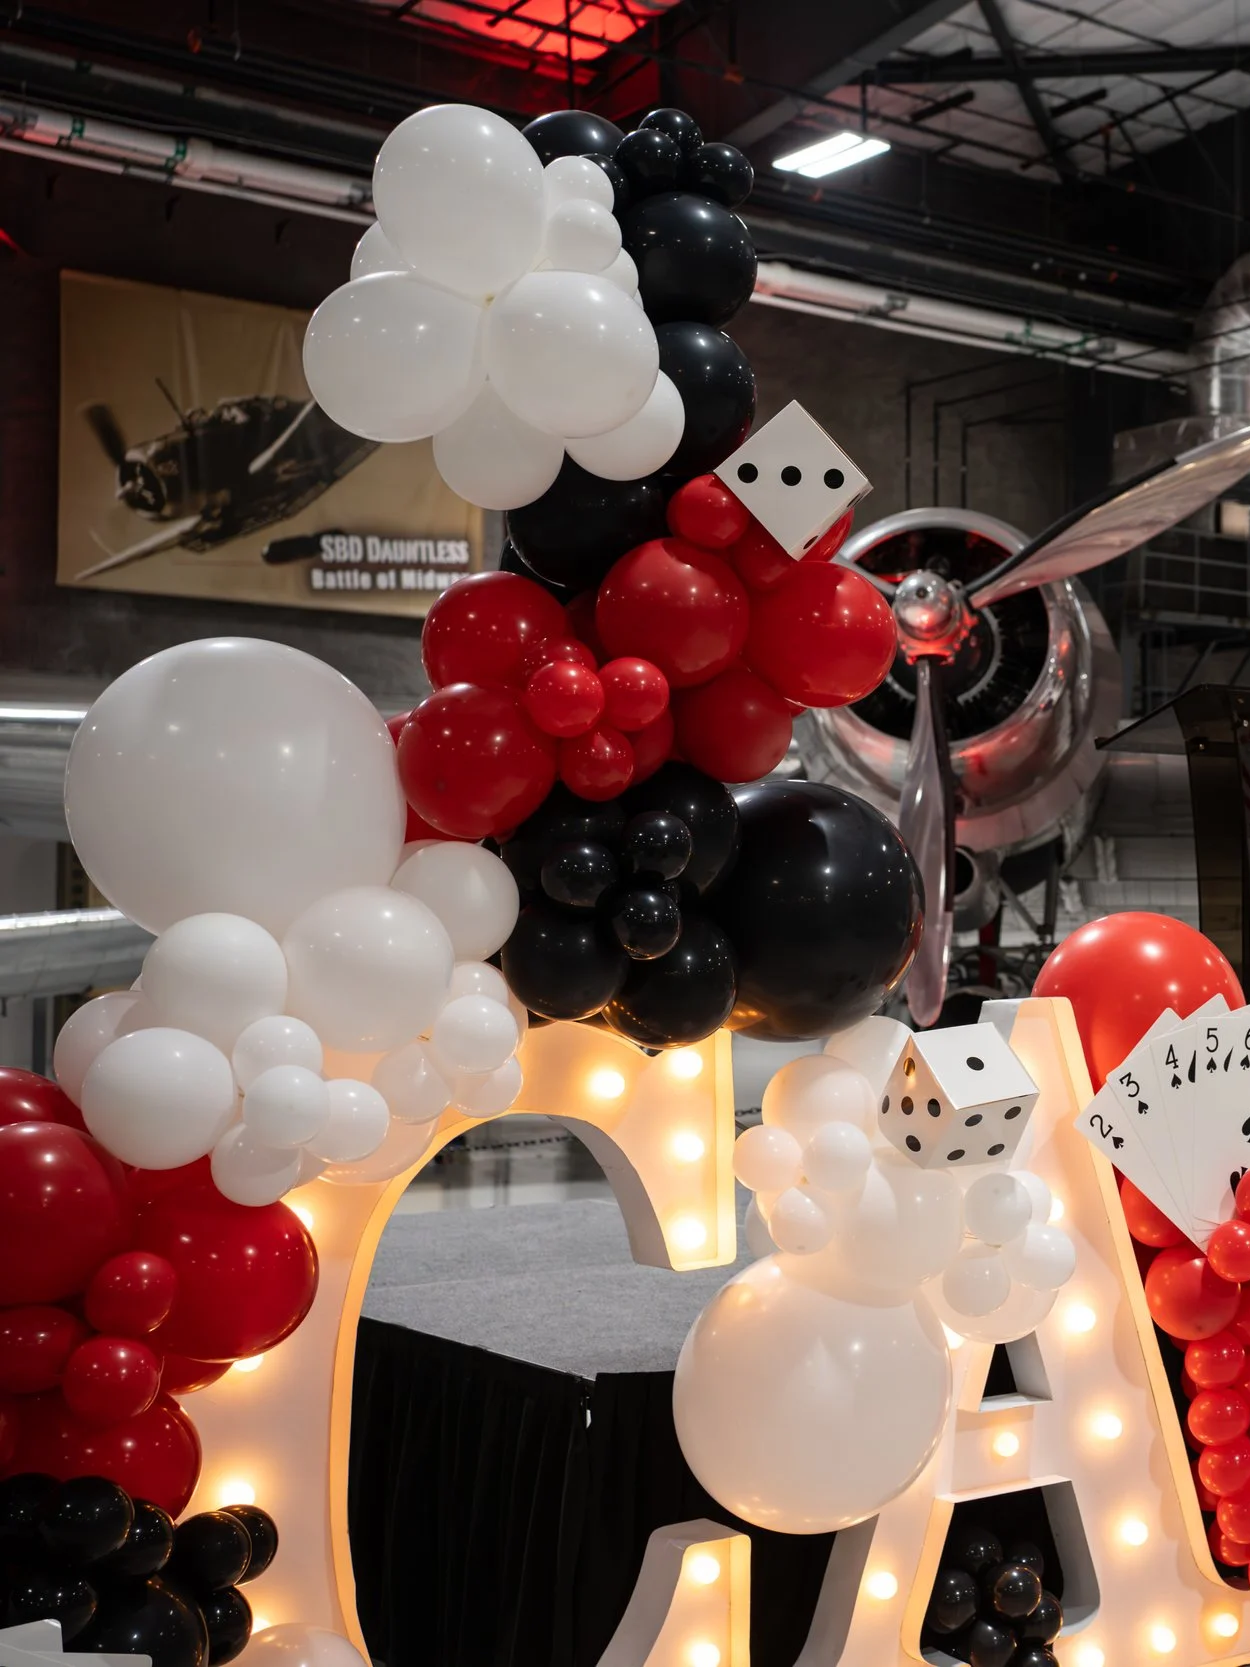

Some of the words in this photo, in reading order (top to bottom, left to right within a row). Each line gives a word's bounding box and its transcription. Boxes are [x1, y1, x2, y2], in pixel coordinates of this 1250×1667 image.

[320, 534, 363, 563] SBD
[366, 535, 470, 564] DAUNTLESS
[311, 568, 372, 590] Battle
[376, 570, 396, 590] of
[401, 568, 470, 590] Midwa
[1089, 1114, 1113, 1139] 2
[1119, 1072, 1140, 1098] 3
[1165, 1044, 1179, 1070] 4
[1206, 1027, 1219, 1053] 5
